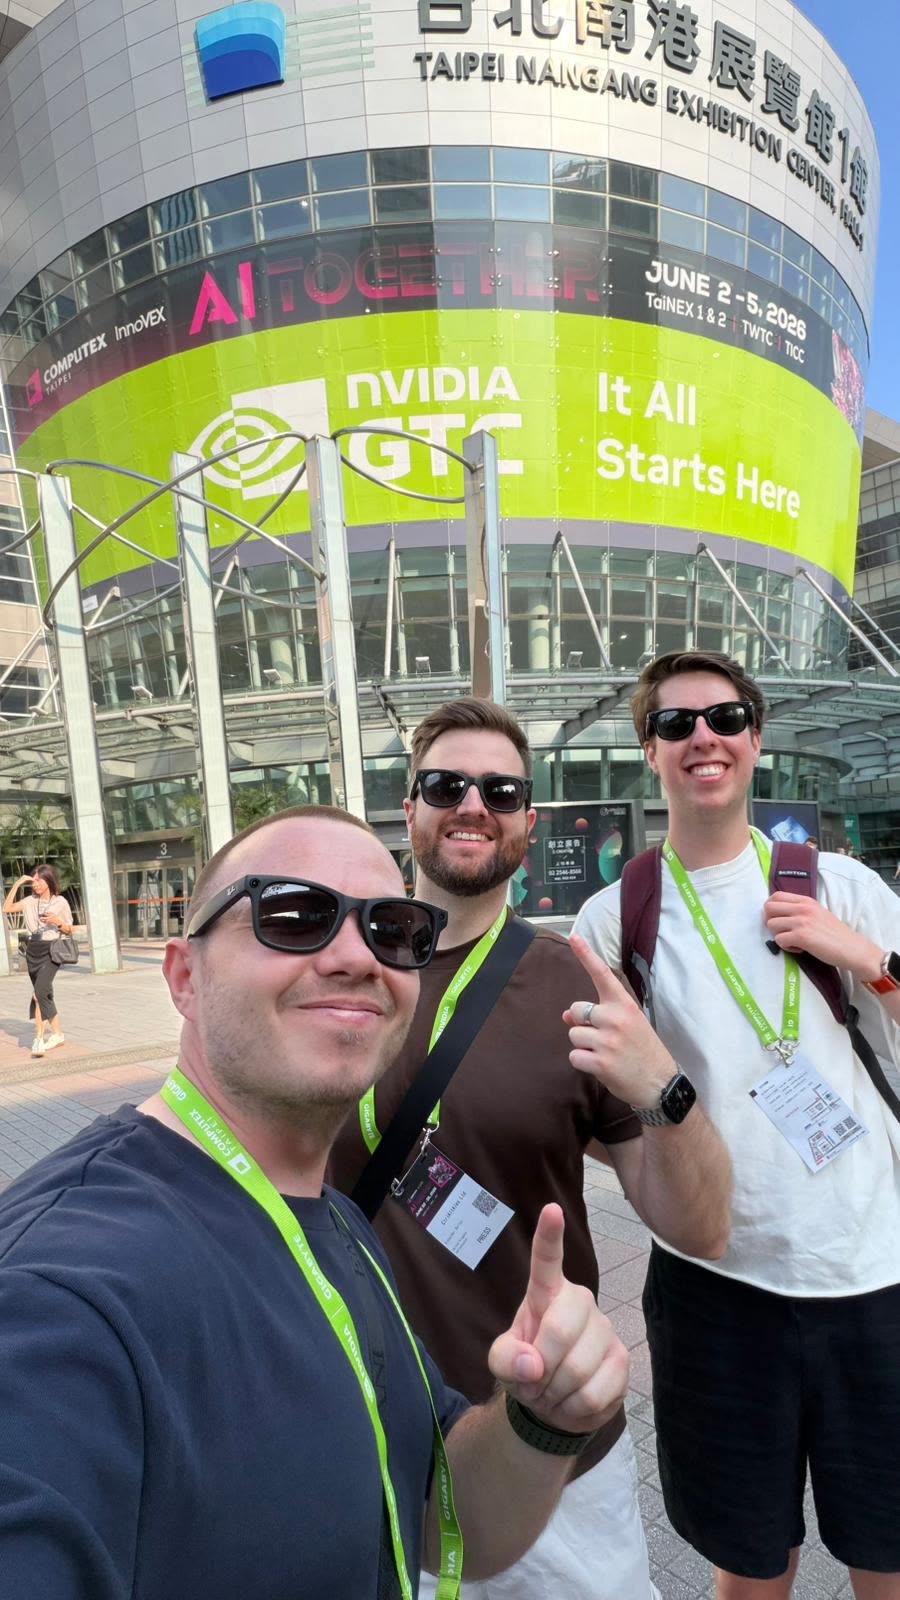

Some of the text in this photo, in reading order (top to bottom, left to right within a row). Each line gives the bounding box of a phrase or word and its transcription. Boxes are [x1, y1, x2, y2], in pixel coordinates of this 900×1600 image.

[414, 51, 506, 82] TAIPEI
[515, 55, 658, 106] NANGANG
[666, 84, 782, 163] EXHIBITION
[786, 148, 837, 214] CENTER,
[189, 243, 602, 336] AI TOGETHER
[645, 260, 711, 298] JUNE
[766, 303, 807, 341] 2026
[43, 306, 166, 385] COMPUTEX InnoVEX
[645, 292, 806, 364] TaiNEX 1 & 2 TWTC TICC
[45, 371, 73, 397] TAIPEI
[598, 372, 697, 427] It All
[597, 438, 801, 519] Starts Here
[160, 842, 168, 856] 3
[188, 1108, 232, 1157] COMPUTEX
[293, 1234, 332, 1300] GIGABYTE
